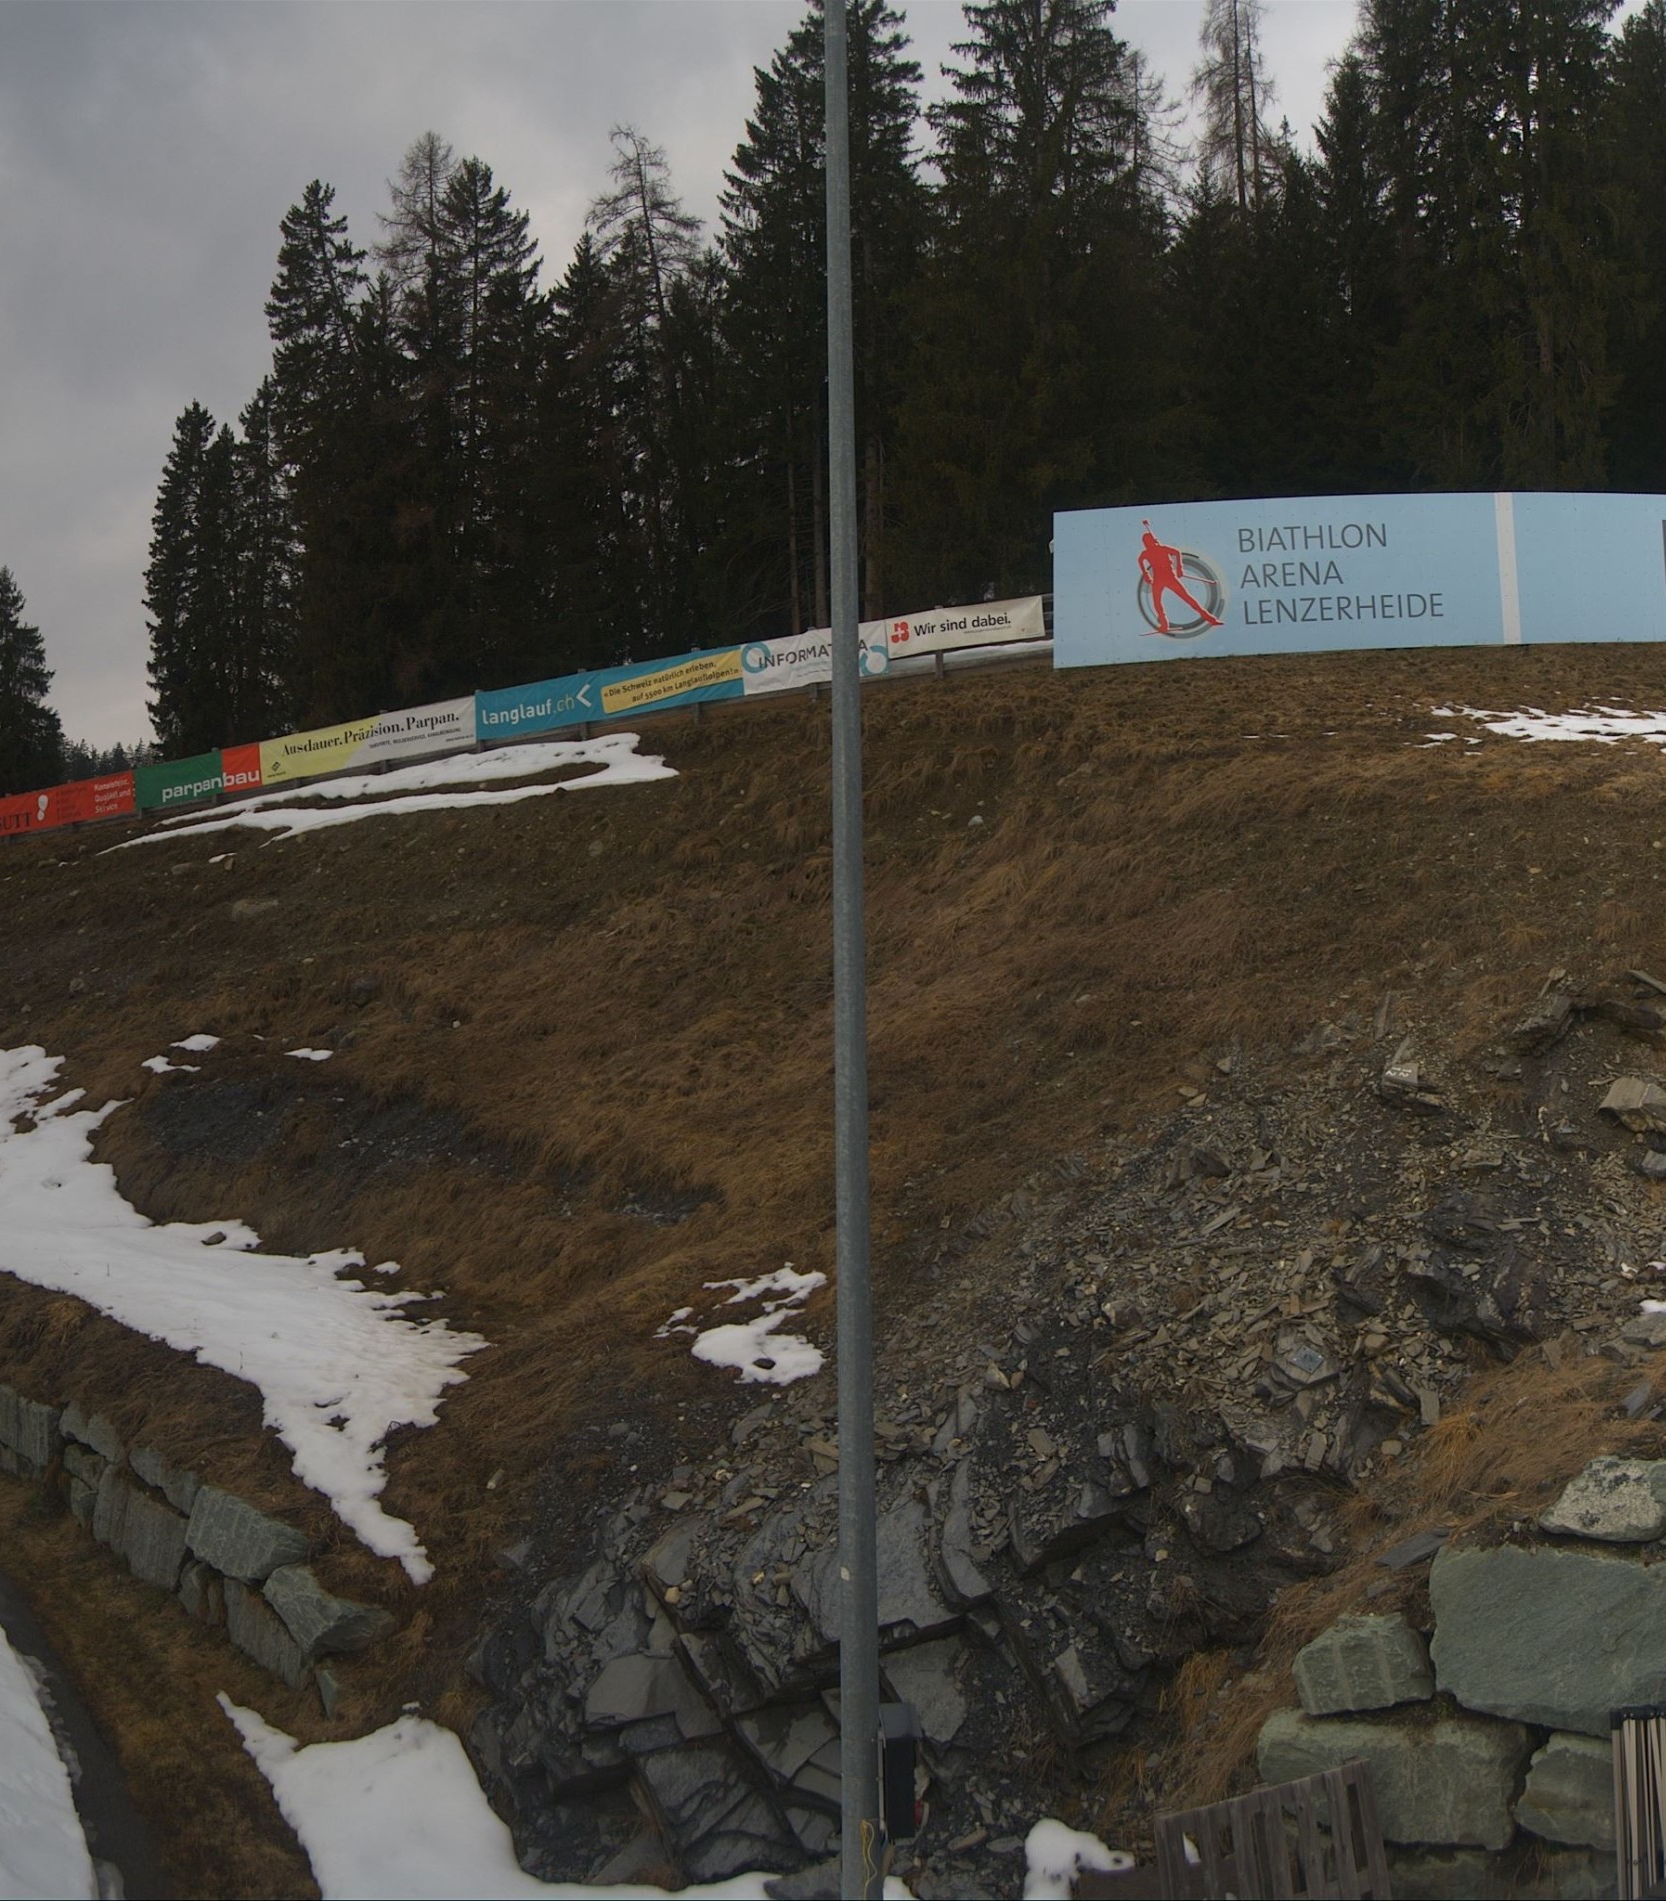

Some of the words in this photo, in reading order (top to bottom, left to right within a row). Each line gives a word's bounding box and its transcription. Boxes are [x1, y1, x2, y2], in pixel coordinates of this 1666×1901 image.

[1238, 523, 1388, 554] BIATHLON
[1241, 560, 1344, 589] ARENA
[914, 622, 937, 636] Wir
[940, 618, 967, 632] sind
[971, 612, 1011, 627] dabei.
[1243, 593, 1444, 625] LENZERHEIDE
[759, 639, 867, 669] INFORMAA
[482, 694, 574, 725] langlauf.ch
[632, 693, 644, 703] auf
[662, 685, 673, 694] km
[282, 733, 343, 756] Ausdauer.
[406, 711, 459, 733] Parpan.
[161, 769, 260, 802] parpanbau
